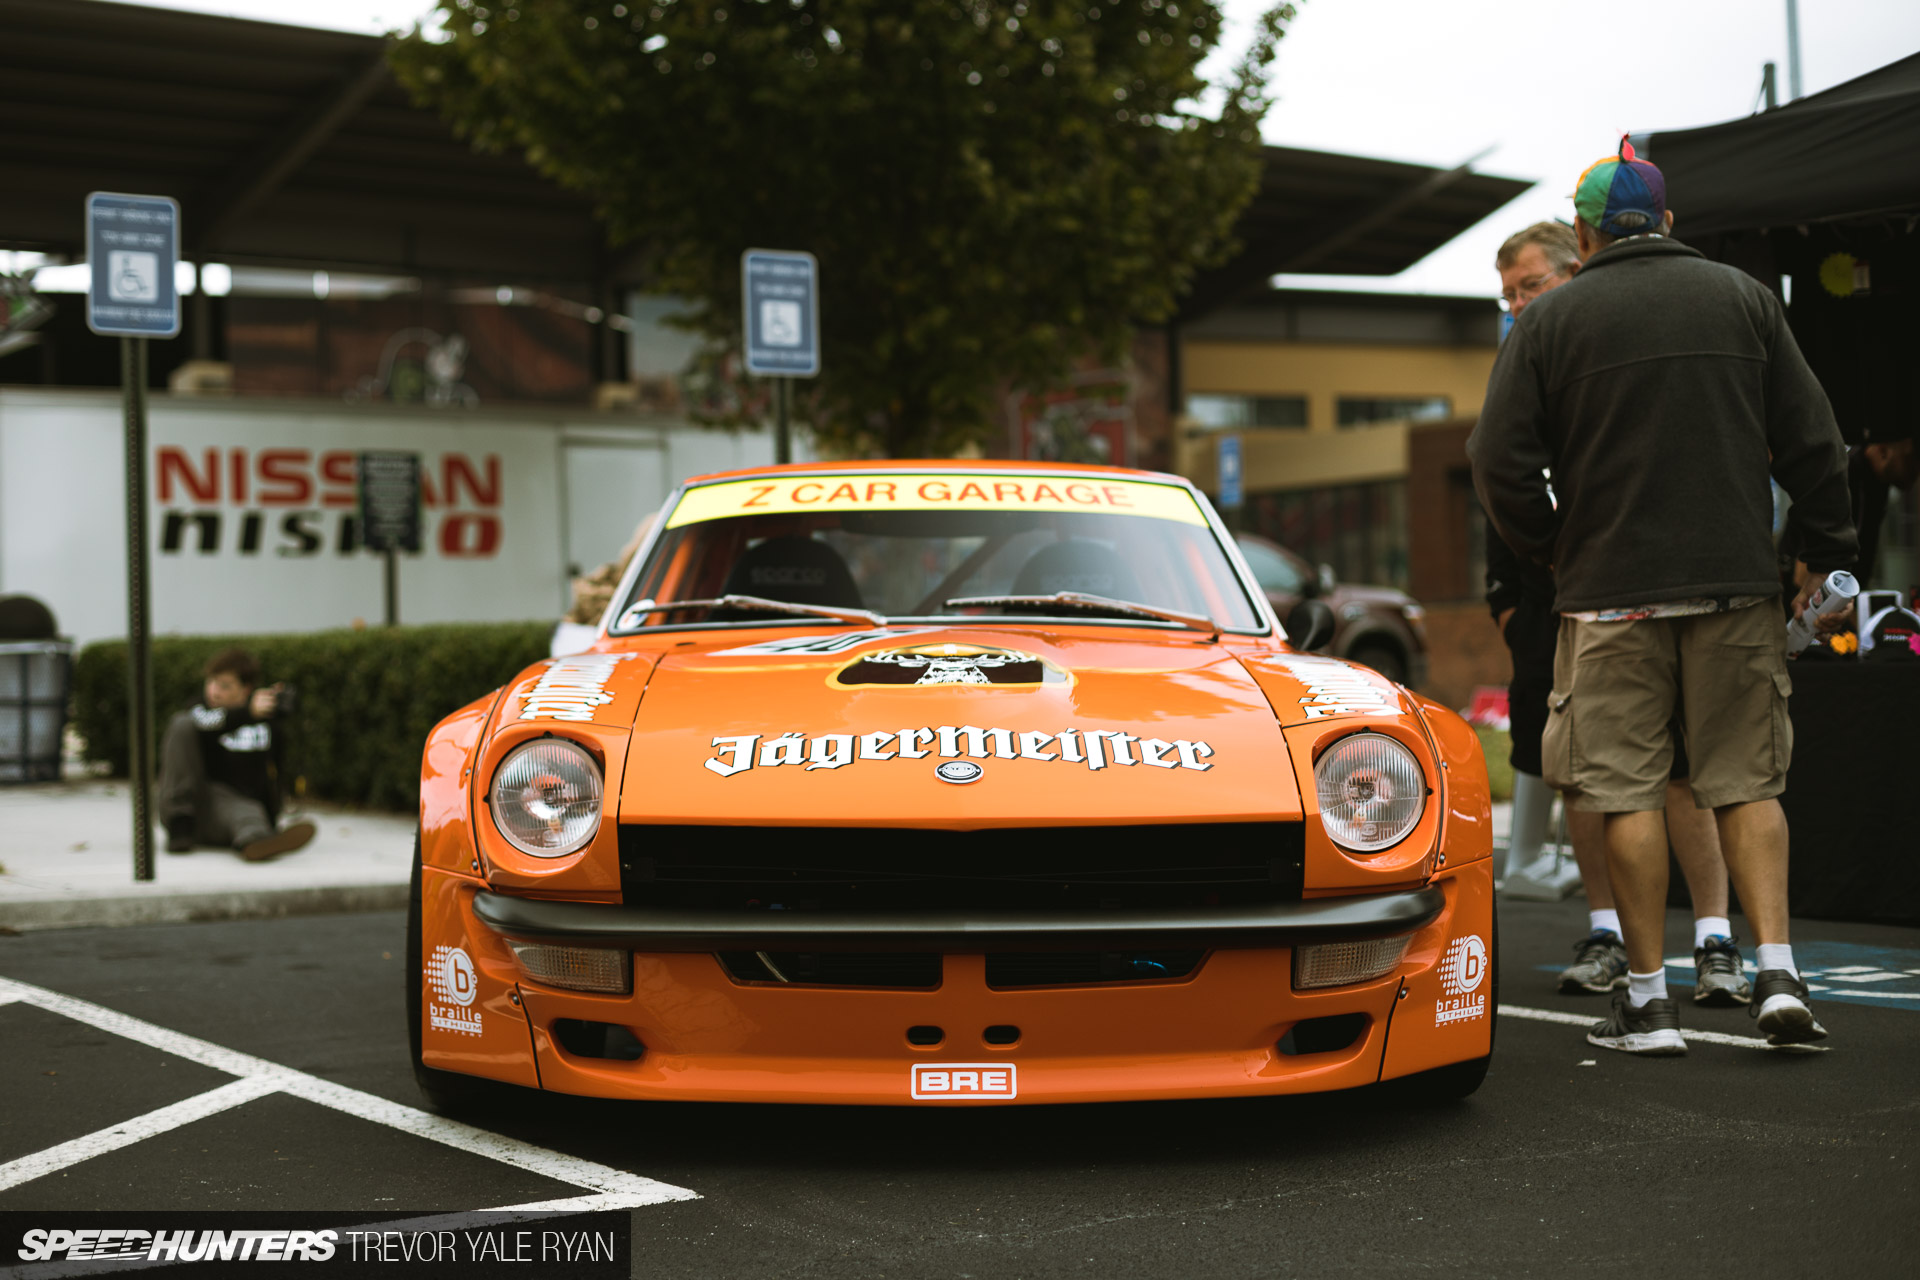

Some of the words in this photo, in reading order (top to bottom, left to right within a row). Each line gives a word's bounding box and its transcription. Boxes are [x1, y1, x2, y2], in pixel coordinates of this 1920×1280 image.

[742, 485, 777, 508] Z
[791, 482, 897, 504] CAR
[918, 481, 1135, 508] GARAGE
[704, 724, 1215, 778] Jägermeister
[430, 1002, 482, 1022] braille
[1436, 993, 1485, 1013] braille
[1436, 1006, 1484, 1021] LITHIUM
[431, 1018, 482, 1032] LITHIUM
[921, 1071, 1007, 1091] BRE
